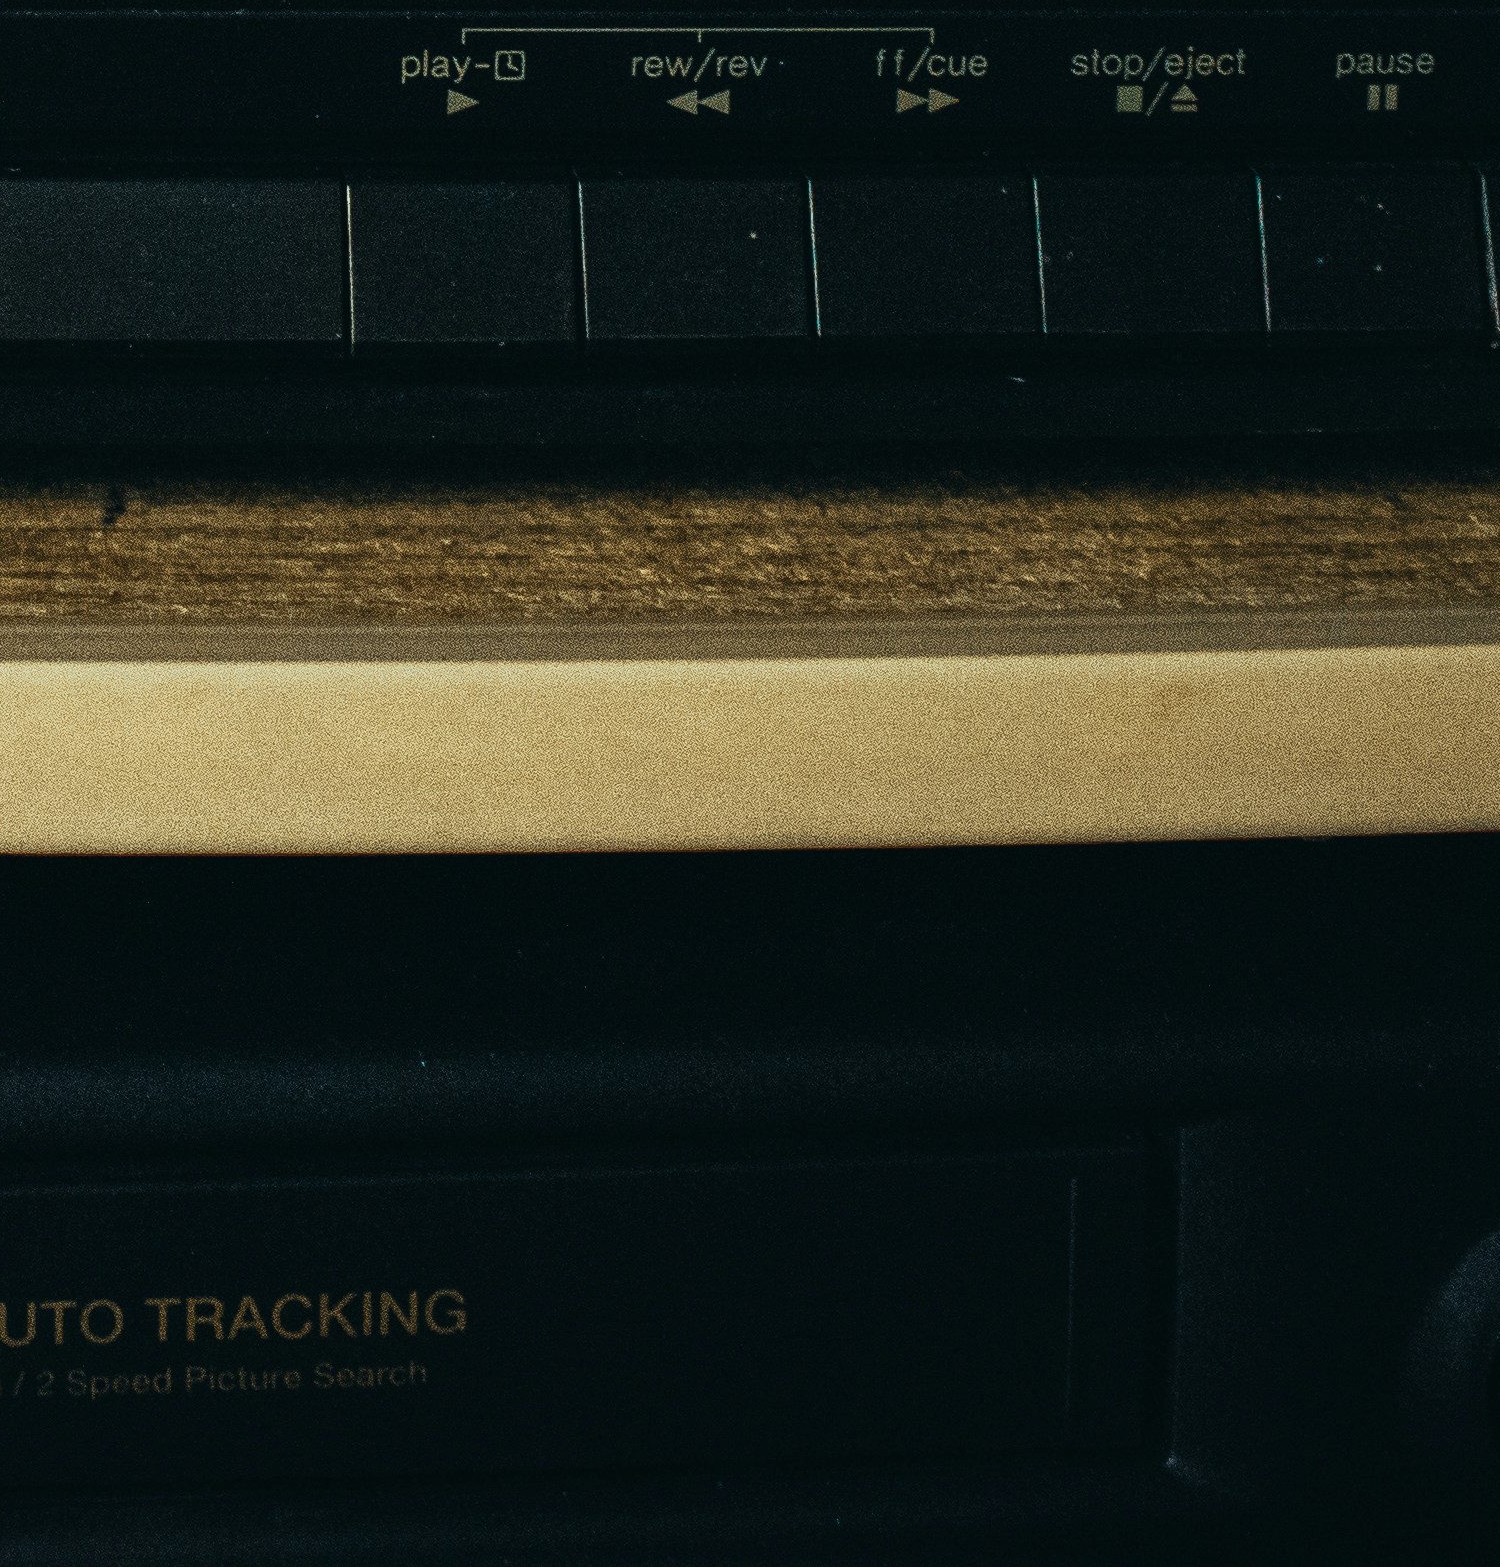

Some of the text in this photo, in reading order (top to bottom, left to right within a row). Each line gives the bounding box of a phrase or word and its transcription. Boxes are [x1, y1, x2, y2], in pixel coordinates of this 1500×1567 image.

[631, 49, 767, 81] rew/rev
[876, 47, 988, 81] ff/cue
[1071, 46, 1245, 80] stop/eject
[1336, 52, 1434, 78] pause
[146, 1290, 466, 1341] TRACKING
[38, 1371, 55, 1396] 2
[68, 1368, 172, 1399] Speed
[185, 1366, 301, 1391] Picture
[314, 1361, 427, 1388] Search
